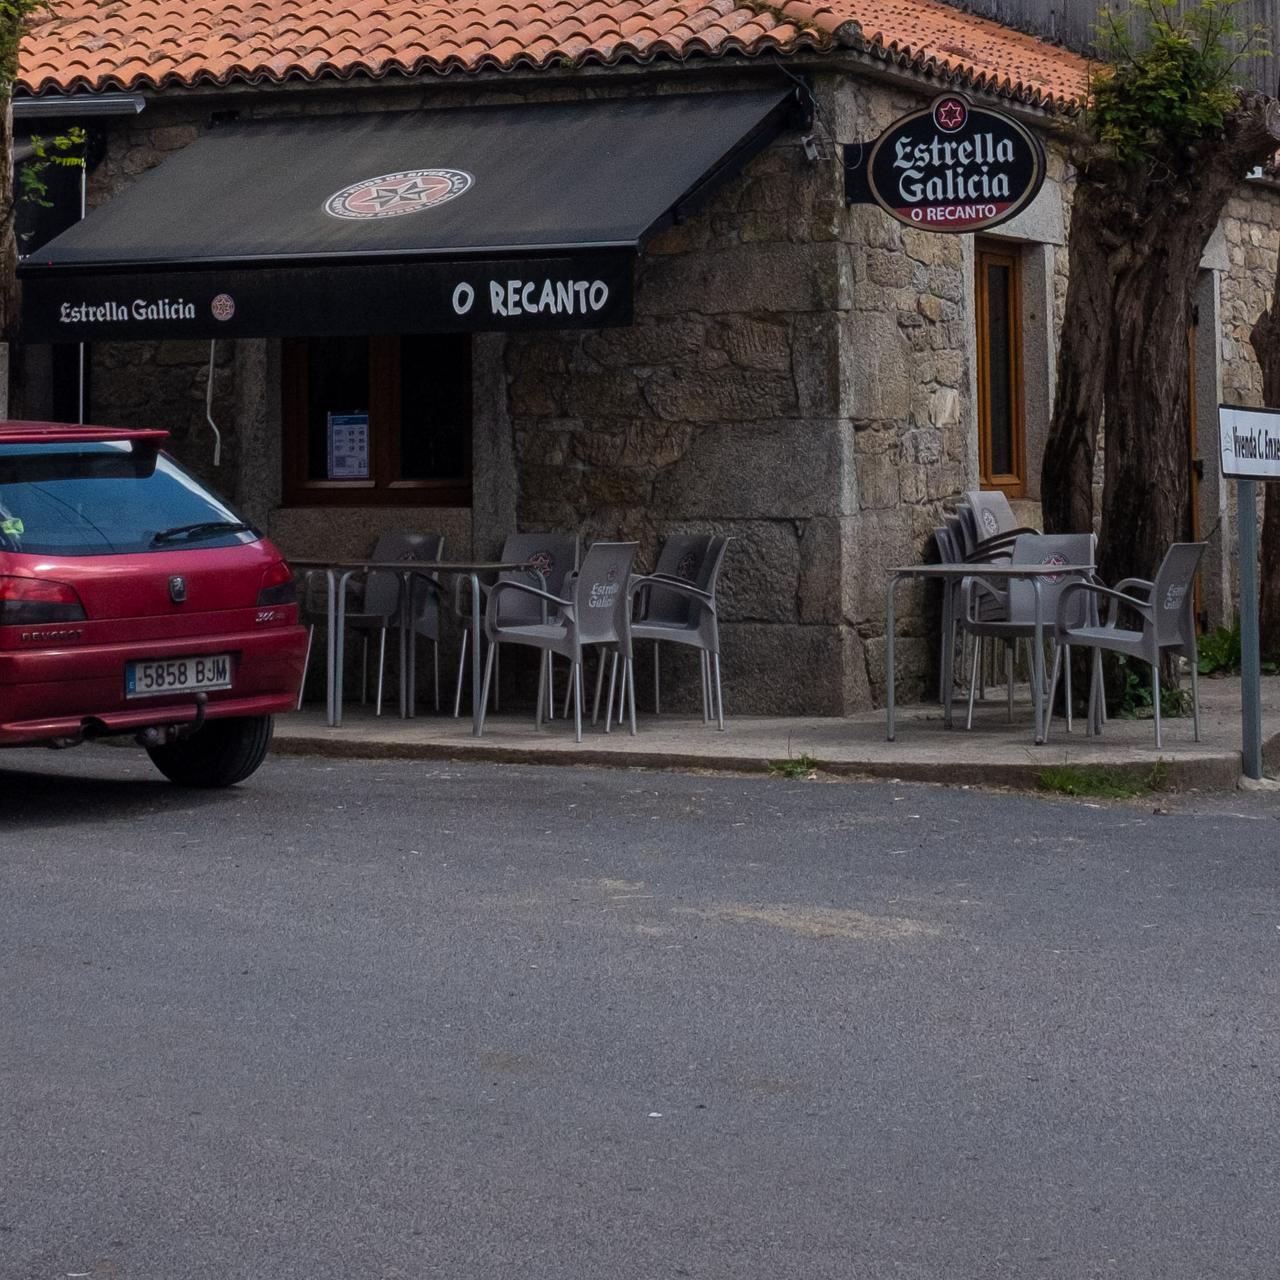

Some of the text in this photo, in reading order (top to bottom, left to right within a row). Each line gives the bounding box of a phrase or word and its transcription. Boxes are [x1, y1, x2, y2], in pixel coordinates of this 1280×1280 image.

[893, 133, 1015, 169] Estrella
[898, 165, 1011, 203] Galicia
[911, 204, 997, 222] O RECANTO
[58, 297, 196, 324] Estrella Galicia
[451, 279, 609, 316] O RECANTO
[143, 661, 188, 689] 5858
[195, 658, 228, 683] BJM
